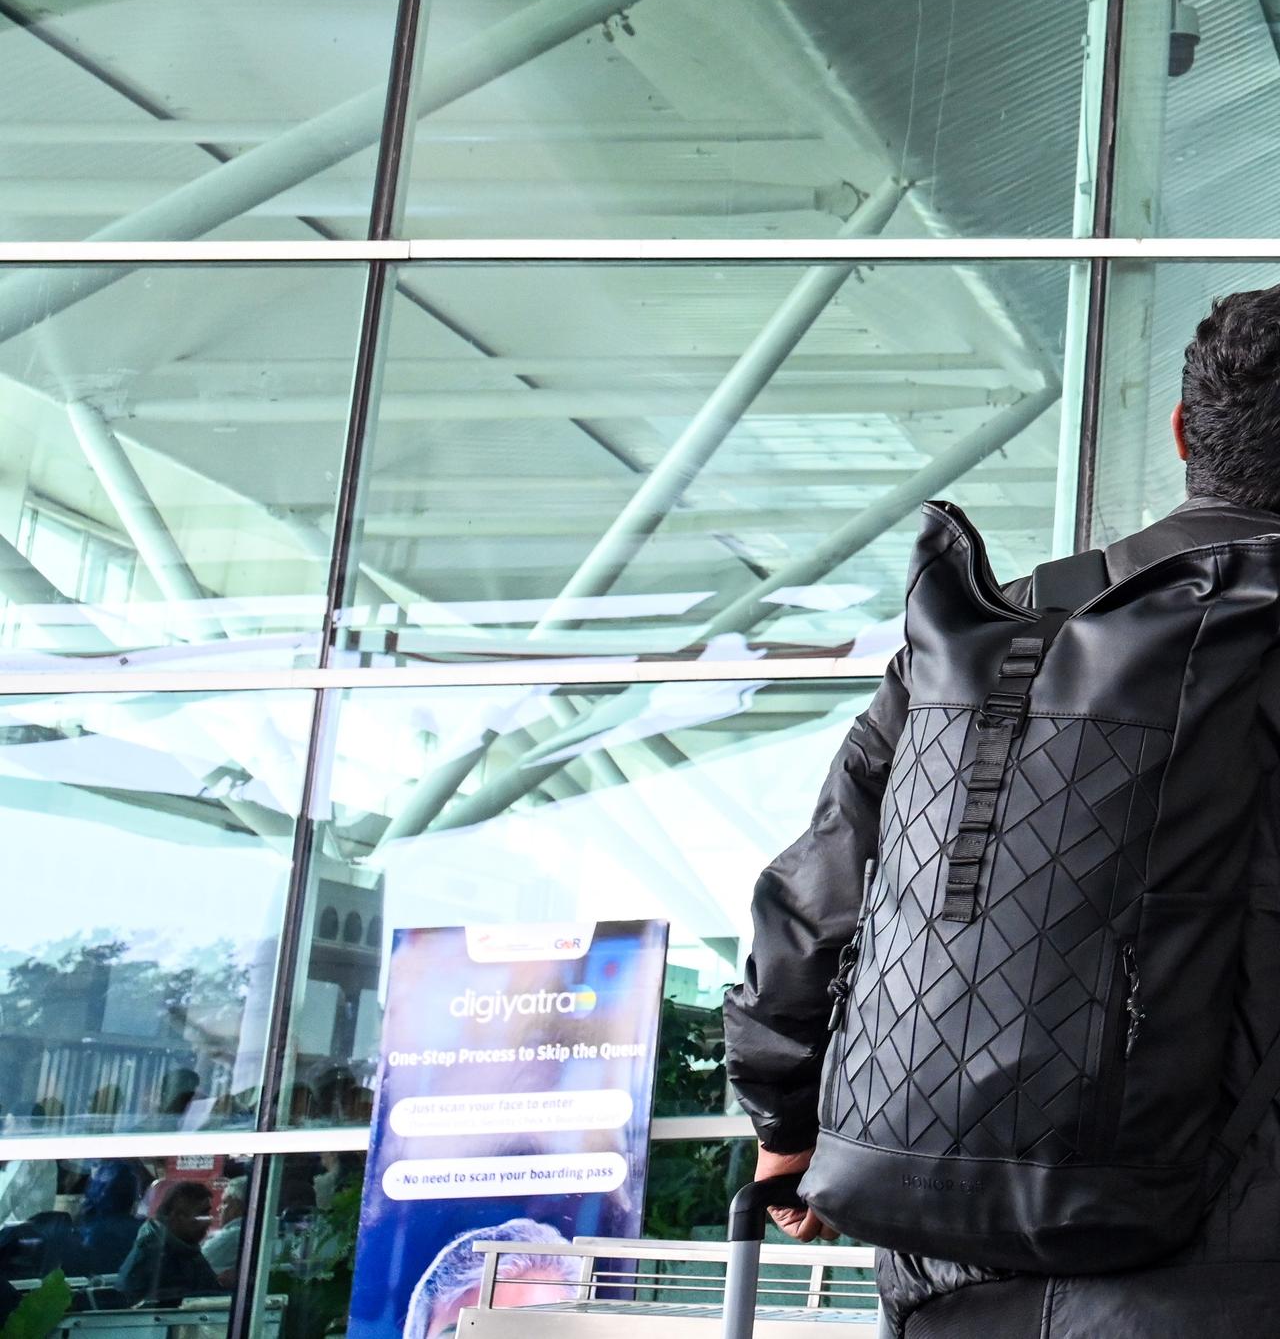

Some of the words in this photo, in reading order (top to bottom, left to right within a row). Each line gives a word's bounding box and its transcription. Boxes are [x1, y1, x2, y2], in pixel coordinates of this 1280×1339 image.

[450, 987, 577, 1024] digiyatra
[389, 1050, 456, 1067] One-Step
[458, 1048, 515, 1063] Process
[518, 1046, 535, 1061] to
[537, 1044, 570, 1062] Skip
[572, 1043, 597, 1059] the
[597, 1038, 646, 1060] Queue
[402, 1173, 419, 1186] No
[422, 1173, 450, 1184] need
[453, 1171, 466, 1183] to
[470, 1173, 496, 1182] scan
[499, 1171, 527, 1186] your
[530, 1168, 583, 1180] boarding
[586, 1167, 613, 1179] pass
